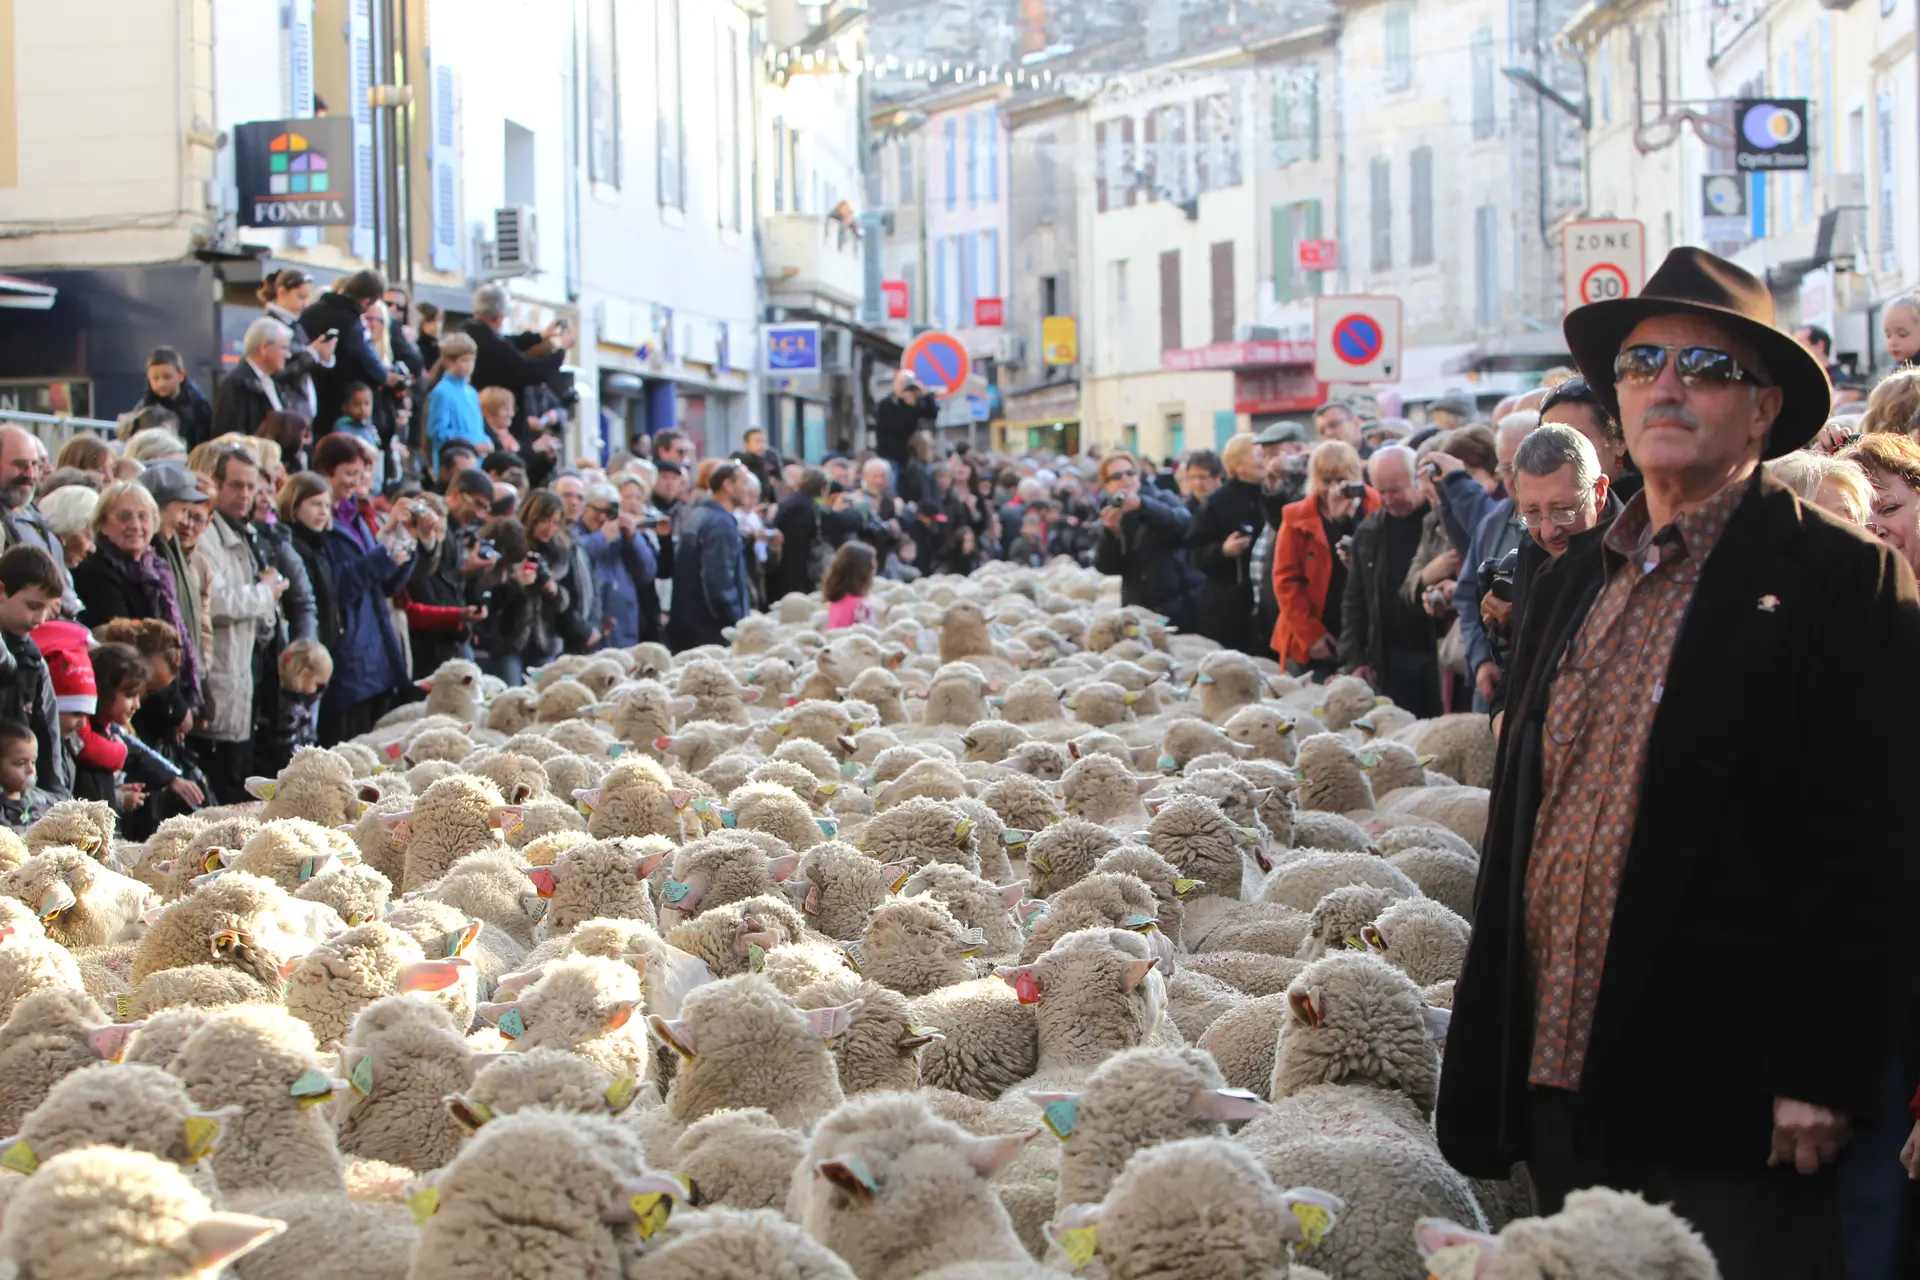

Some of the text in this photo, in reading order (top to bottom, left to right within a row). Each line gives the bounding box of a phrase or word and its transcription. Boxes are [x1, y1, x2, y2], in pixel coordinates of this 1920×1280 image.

[254, 200, 345, 222] FONCIA
[1575, 231, 1631, 251] ZONE
[1591, 276, 1620, 299] 30
